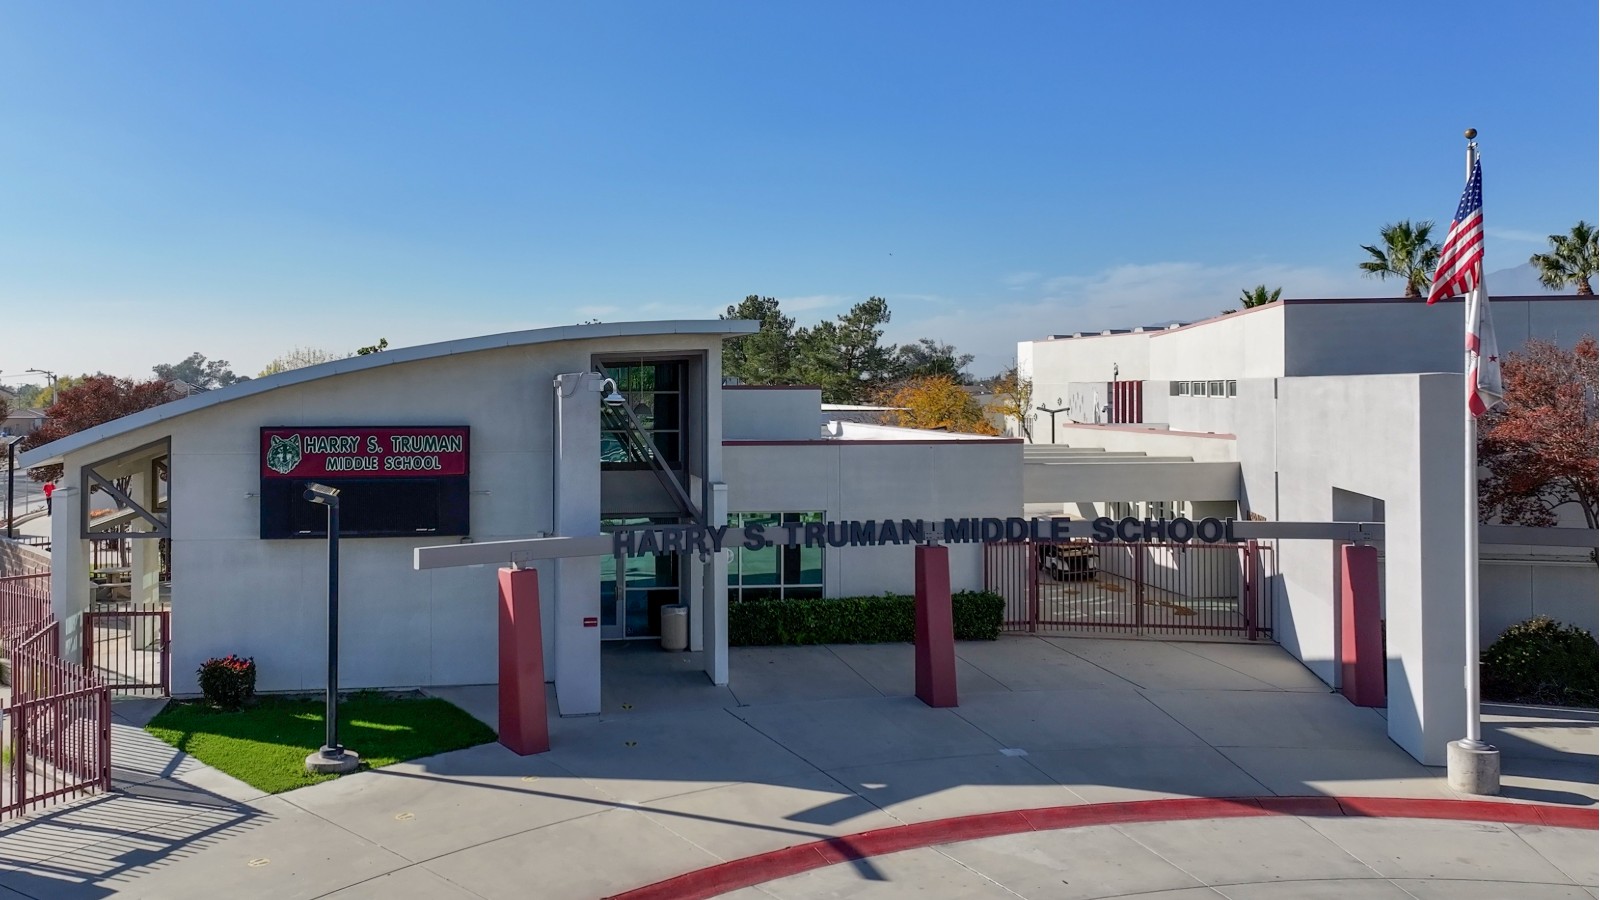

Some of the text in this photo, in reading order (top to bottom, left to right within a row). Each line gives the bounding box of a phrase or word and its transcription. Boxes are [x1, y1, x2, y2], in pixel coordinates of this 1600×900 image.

[304, 435, 463, 453] HARRY S. TRUMAN
[326, 456, 441, 471] MIDDLE SCHOOL
[613, 516, 1244, 559] HARRY S. TRUMAN MIDDLE SCHOOL
